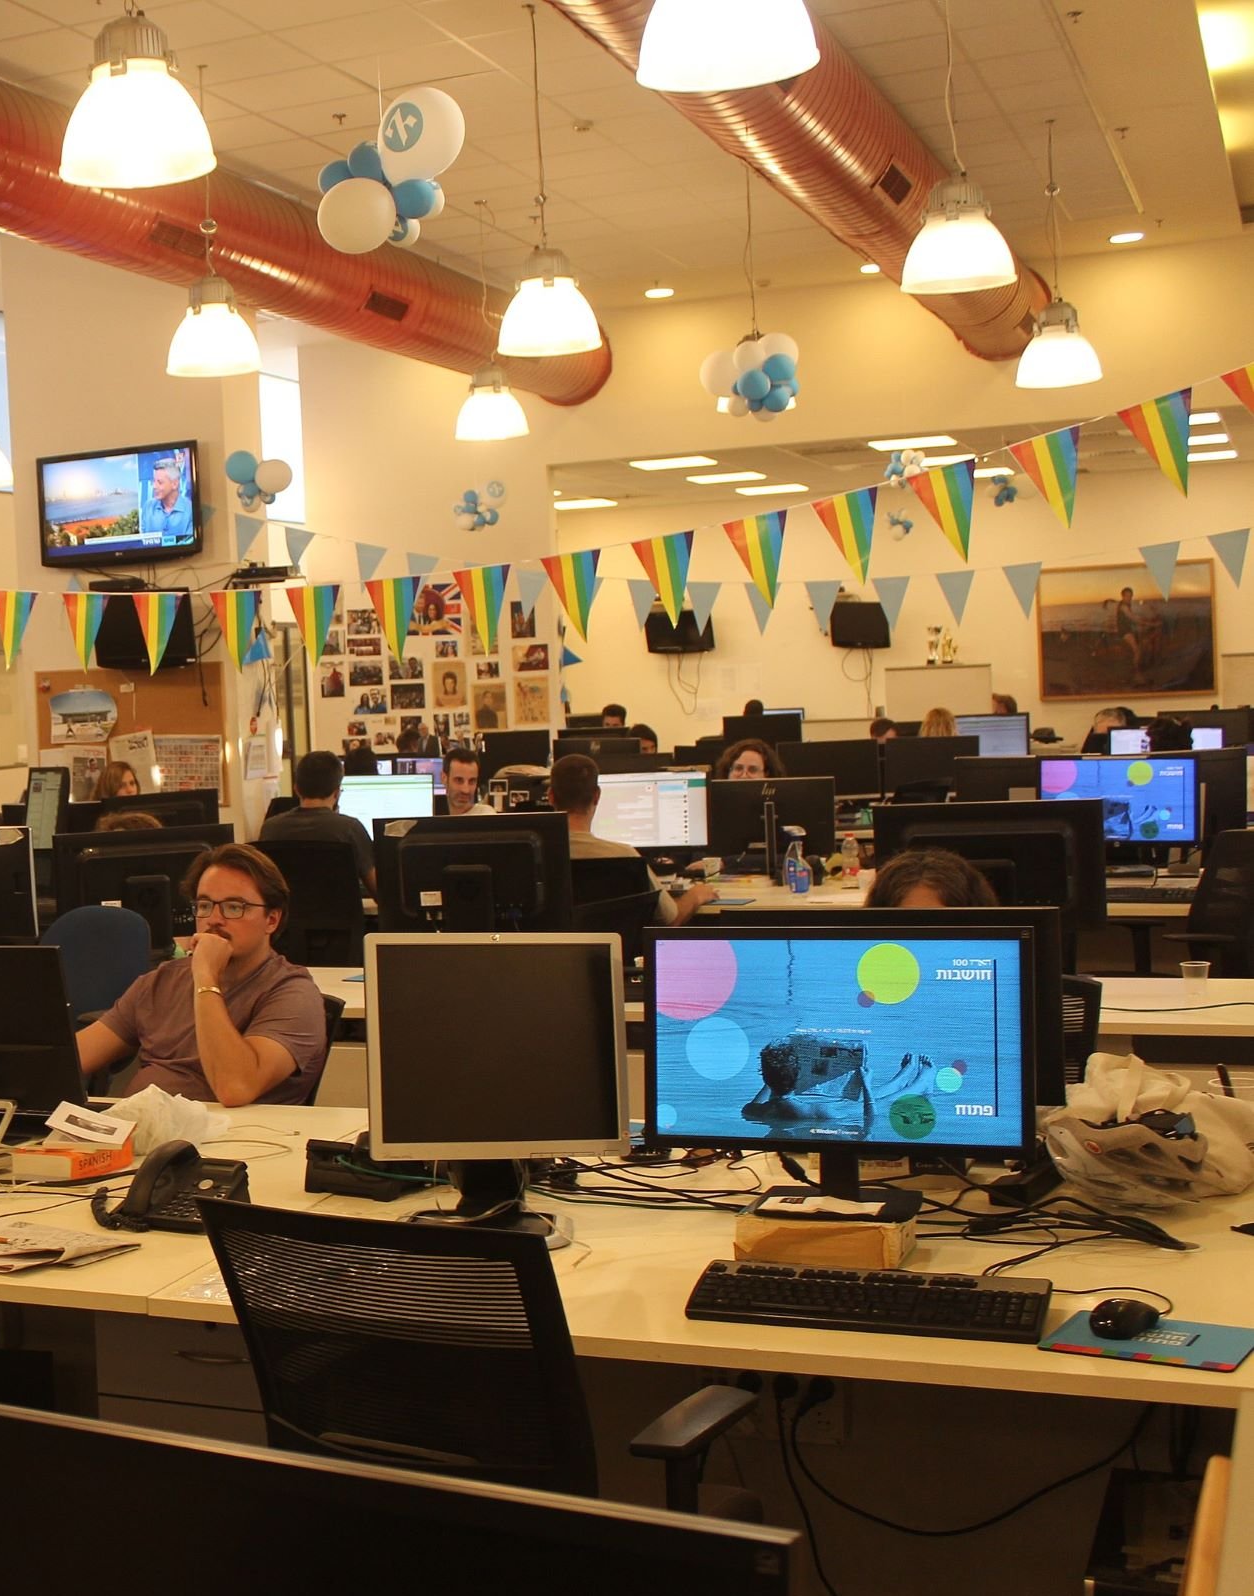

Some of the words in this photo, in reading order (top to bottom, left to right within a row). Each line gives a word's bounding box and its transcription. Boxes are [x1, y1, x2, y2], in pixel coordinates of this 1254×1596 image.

[384, 107, 417, 147] א
[952, 958, 969, 967] 100
[935, 969, 992, 981] חושבות
[955, 1104, 993, 1116] פתוח
[78, 1152, 113, 1171] SPANISH
